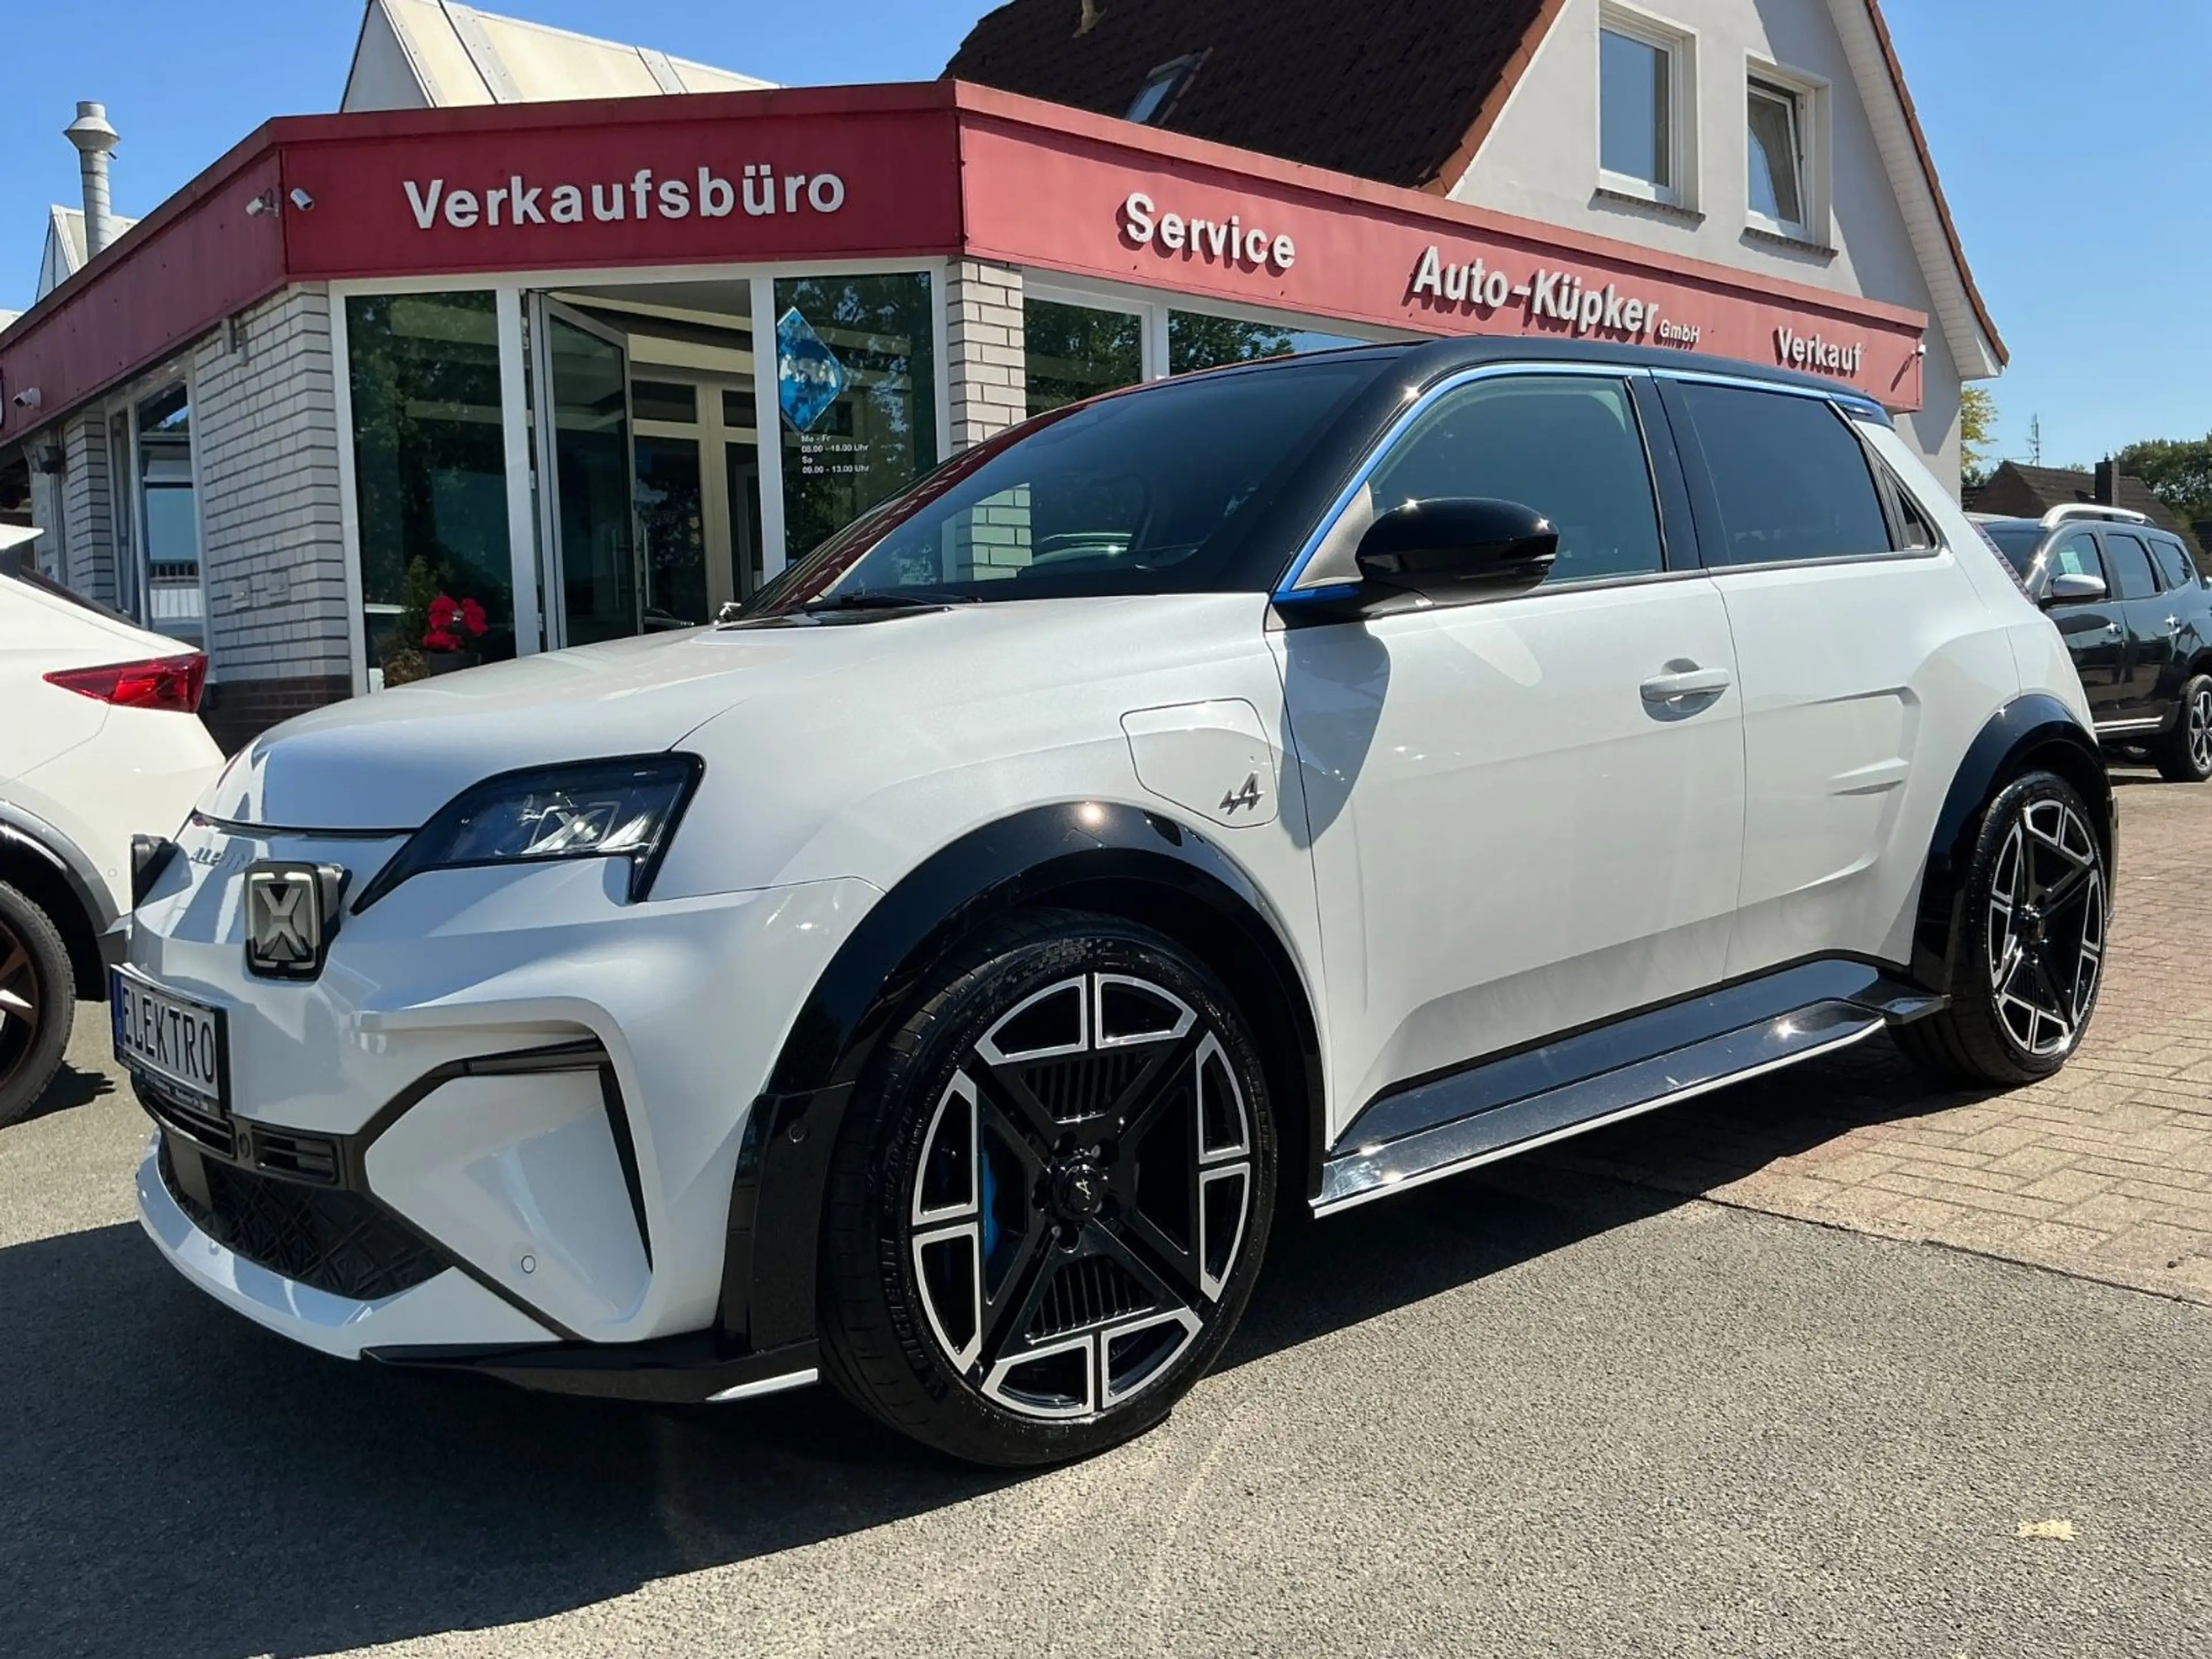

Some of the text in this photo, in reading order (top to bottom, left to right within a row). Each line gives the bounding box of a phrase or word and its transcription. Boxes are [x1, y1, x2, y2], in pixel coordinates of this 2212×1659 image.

[404, 165, 845, 229] Verkaufsbüro
[1126, 192, 1295, 268] Service
[1413, 245, 1700, 343] Auto-Küpker GmbH
[1778, 325, 1862, 372] Verkauf
[802, 456, 813, 464] Sa
[822, 434, 830, 442] Fr
[854, 443, 869, 451] Uhr
[832, 464, 853, 473] 13.00
[854, 464, 870, 473] Uhr
[122, 985, 215, 1085] ELEKTRO
